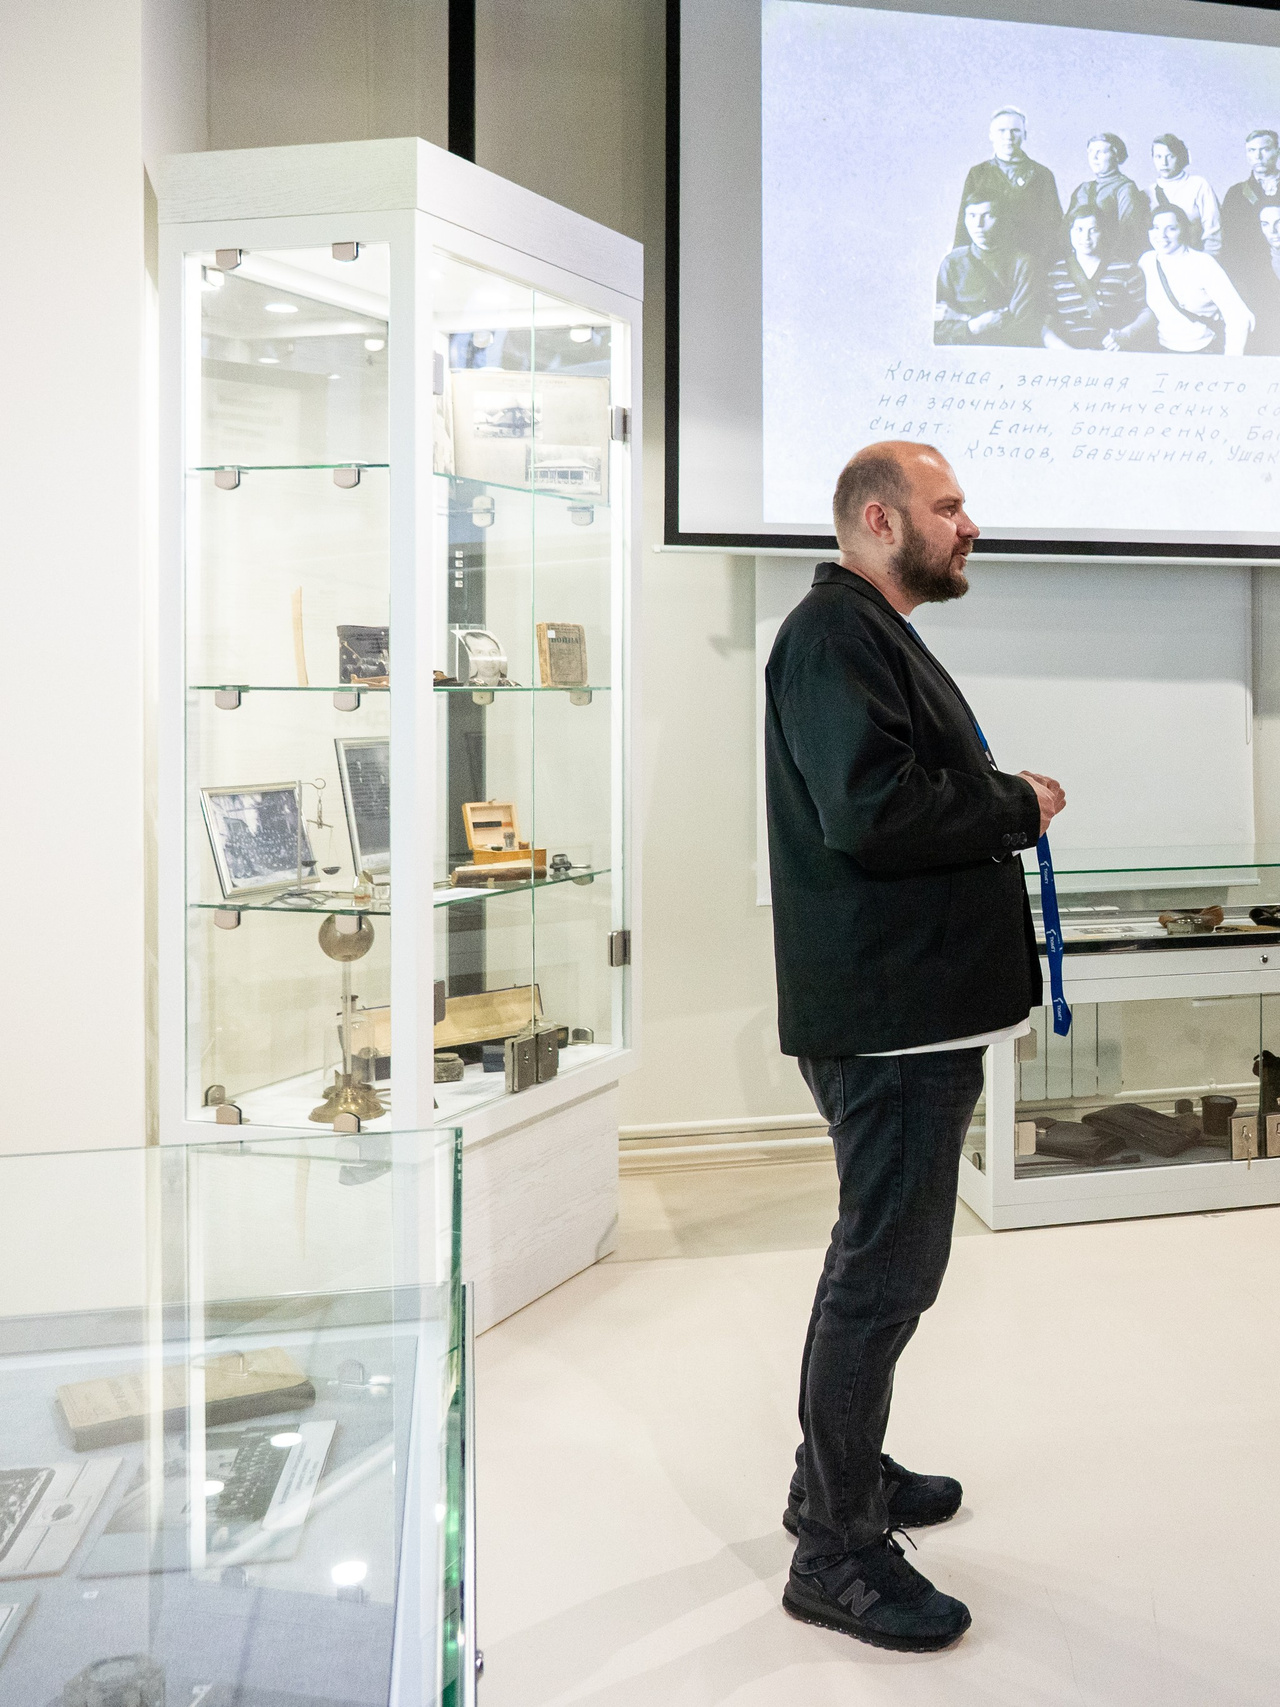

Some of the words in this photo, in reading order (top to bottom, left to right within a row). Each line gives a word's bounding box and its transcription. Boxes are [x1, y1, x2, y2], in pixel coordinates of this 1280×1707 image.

[1016, 373, 1130, 393] занявшая
[1174, 380, 1247, 394] место
[877, 393, 908, 408] на
[926, 395, 1034, 413] заочных
[1069, 400, 1230, 419] химических
[988, 419, 1055, 439] Елин,
[1071, 421, 1229, 445] Бондаренко,
[964, 438, 1056, 464] Козлов,
[1071, 443, 1215, 466] Бабушкина,
[837, 1578, 881, 1617] N
